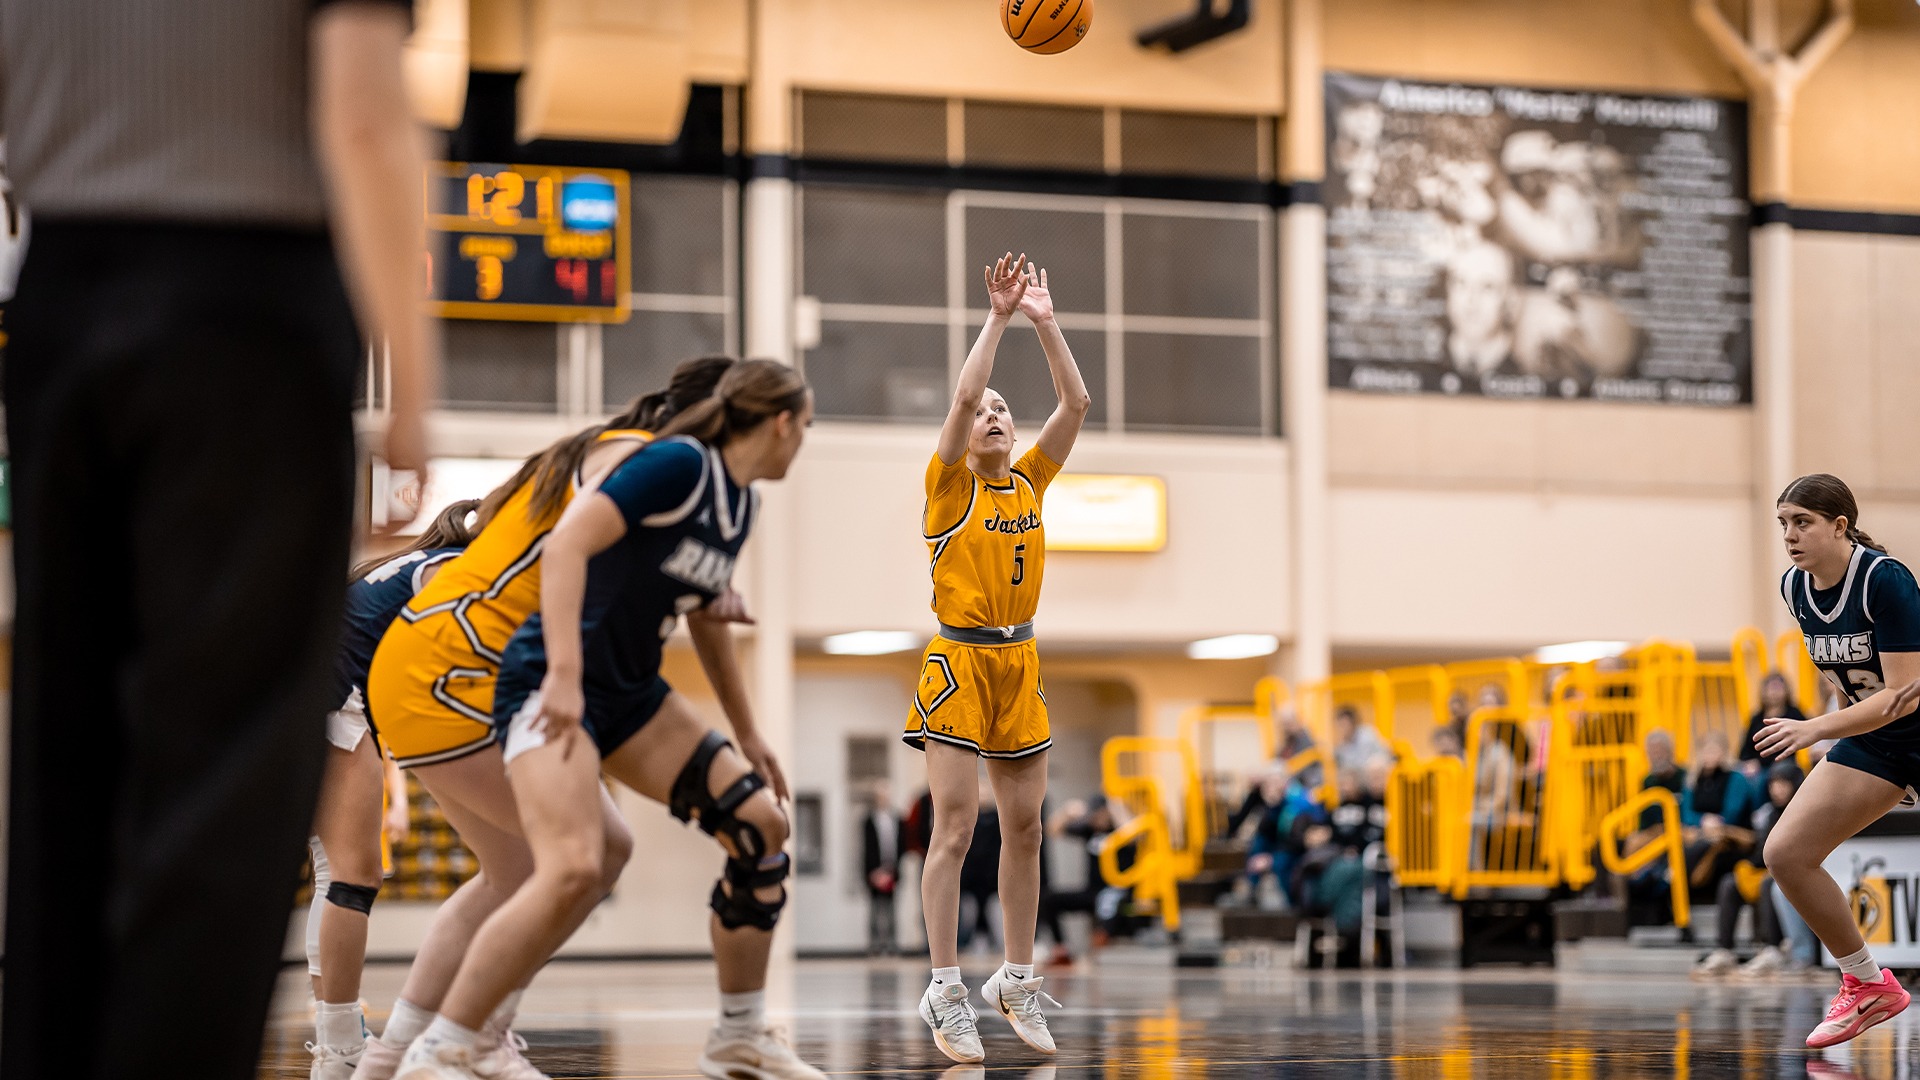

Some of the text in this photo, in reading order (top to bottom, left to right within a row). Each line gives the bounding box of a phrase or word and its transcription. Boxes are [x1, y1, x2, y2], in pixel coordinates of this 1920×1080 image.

[467, 172, 554, 226] 1:21
[476, 256, 503, 300] 3
[555, 258, 616, 304] 41
[984, 507, 1041, 534] Jackets
[660, 537, 736, 594] RAM
[1010, 544, 1026, 586] 5
